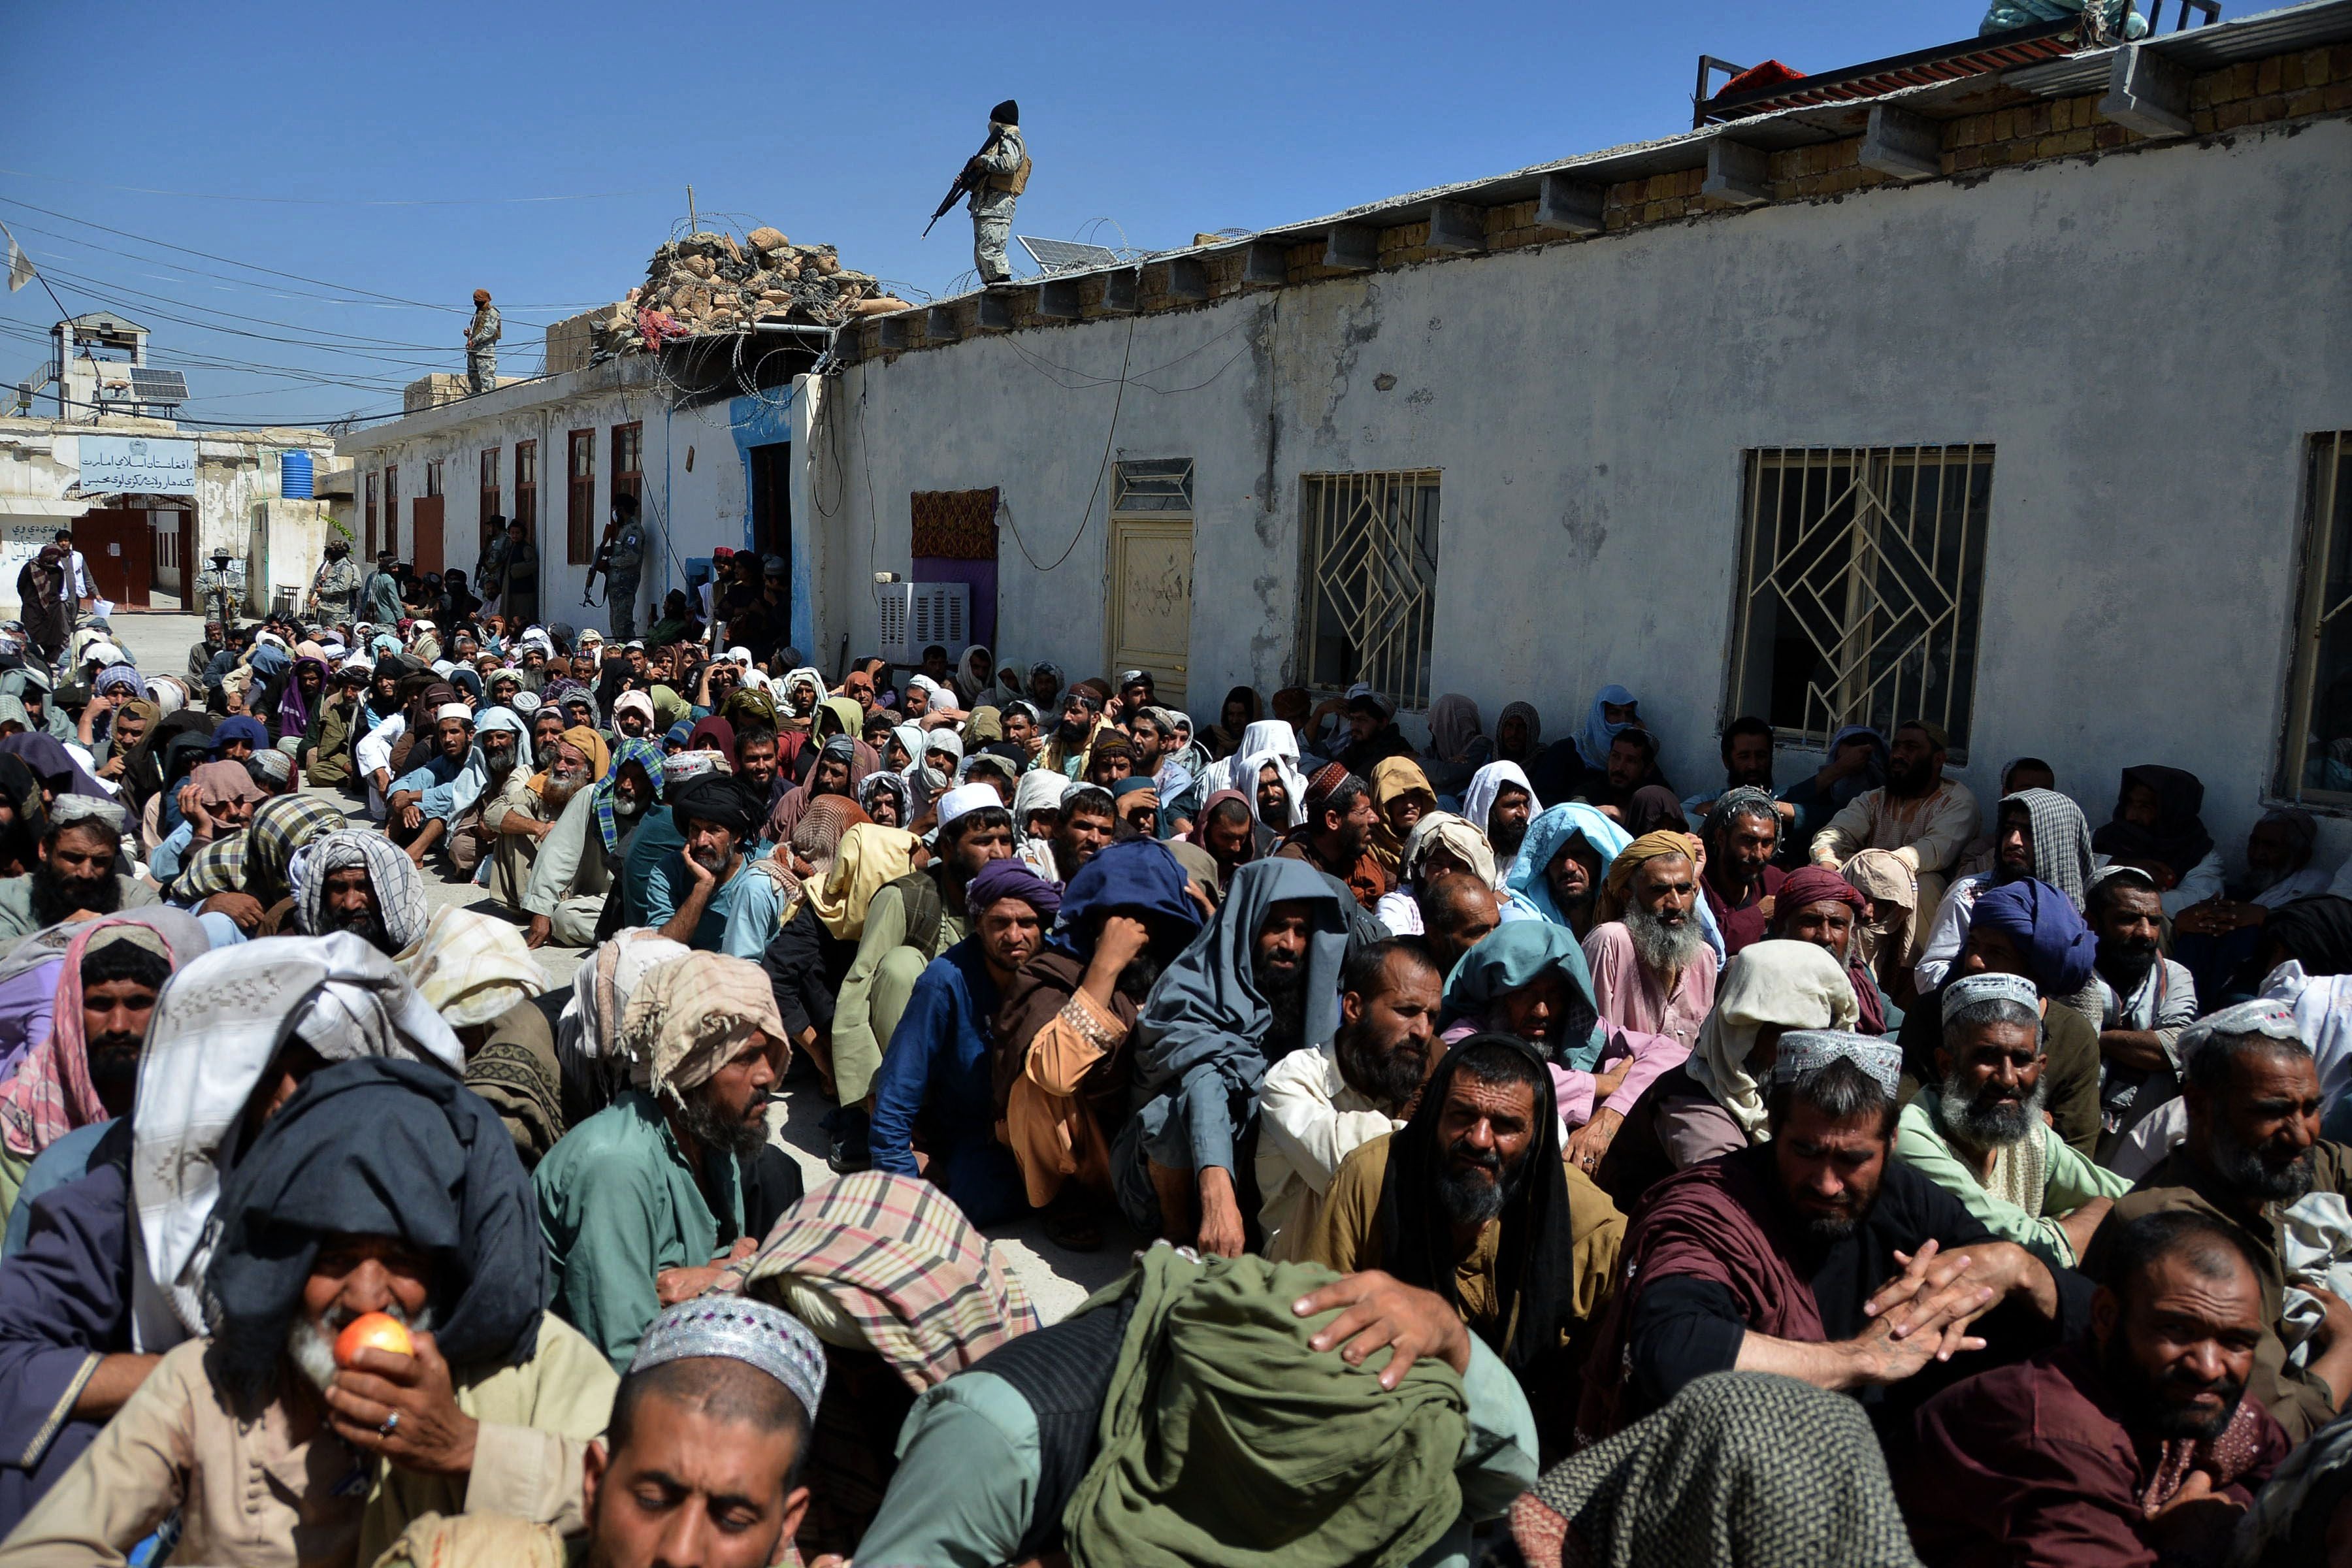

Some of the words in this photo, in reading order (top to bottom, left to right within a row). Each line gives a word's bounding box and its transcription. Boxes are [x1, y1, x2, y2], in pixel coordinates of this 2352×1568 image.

[81, 453, 114, 466] امارت
[114, 456, 146, 469] اسلامي
[147, 455, 189, 469] افغانستان
[83, 476, 110, 487] محبس
